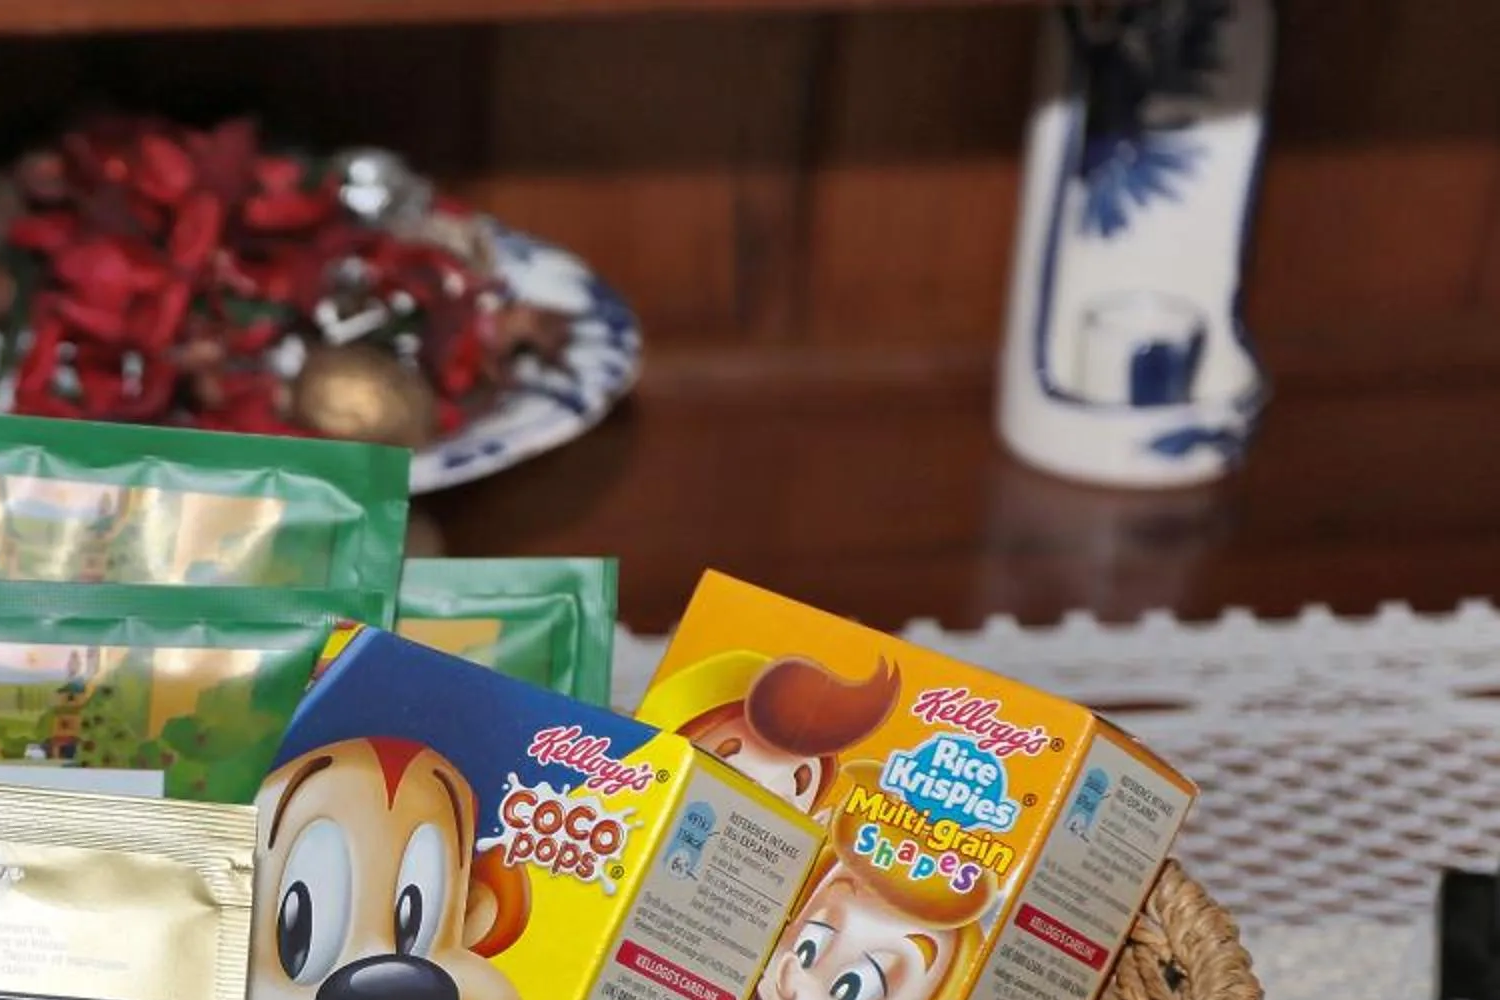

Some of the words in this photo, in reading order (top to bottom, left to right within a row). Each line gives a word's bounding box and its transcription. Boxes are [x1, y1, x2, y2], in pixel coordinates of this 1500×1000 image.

[912, 688, 1049, 757] Kellogg's
[528, 725, 654, 796] Kellogg's
[887, 755, 1015, 826] Krispies
[931, 738, 998, 787] Rice
[506, 831, 598, 878] pops
[845, 784, 1015, 875] Multi-grain
[854, 824, 980, 892] Shapes
